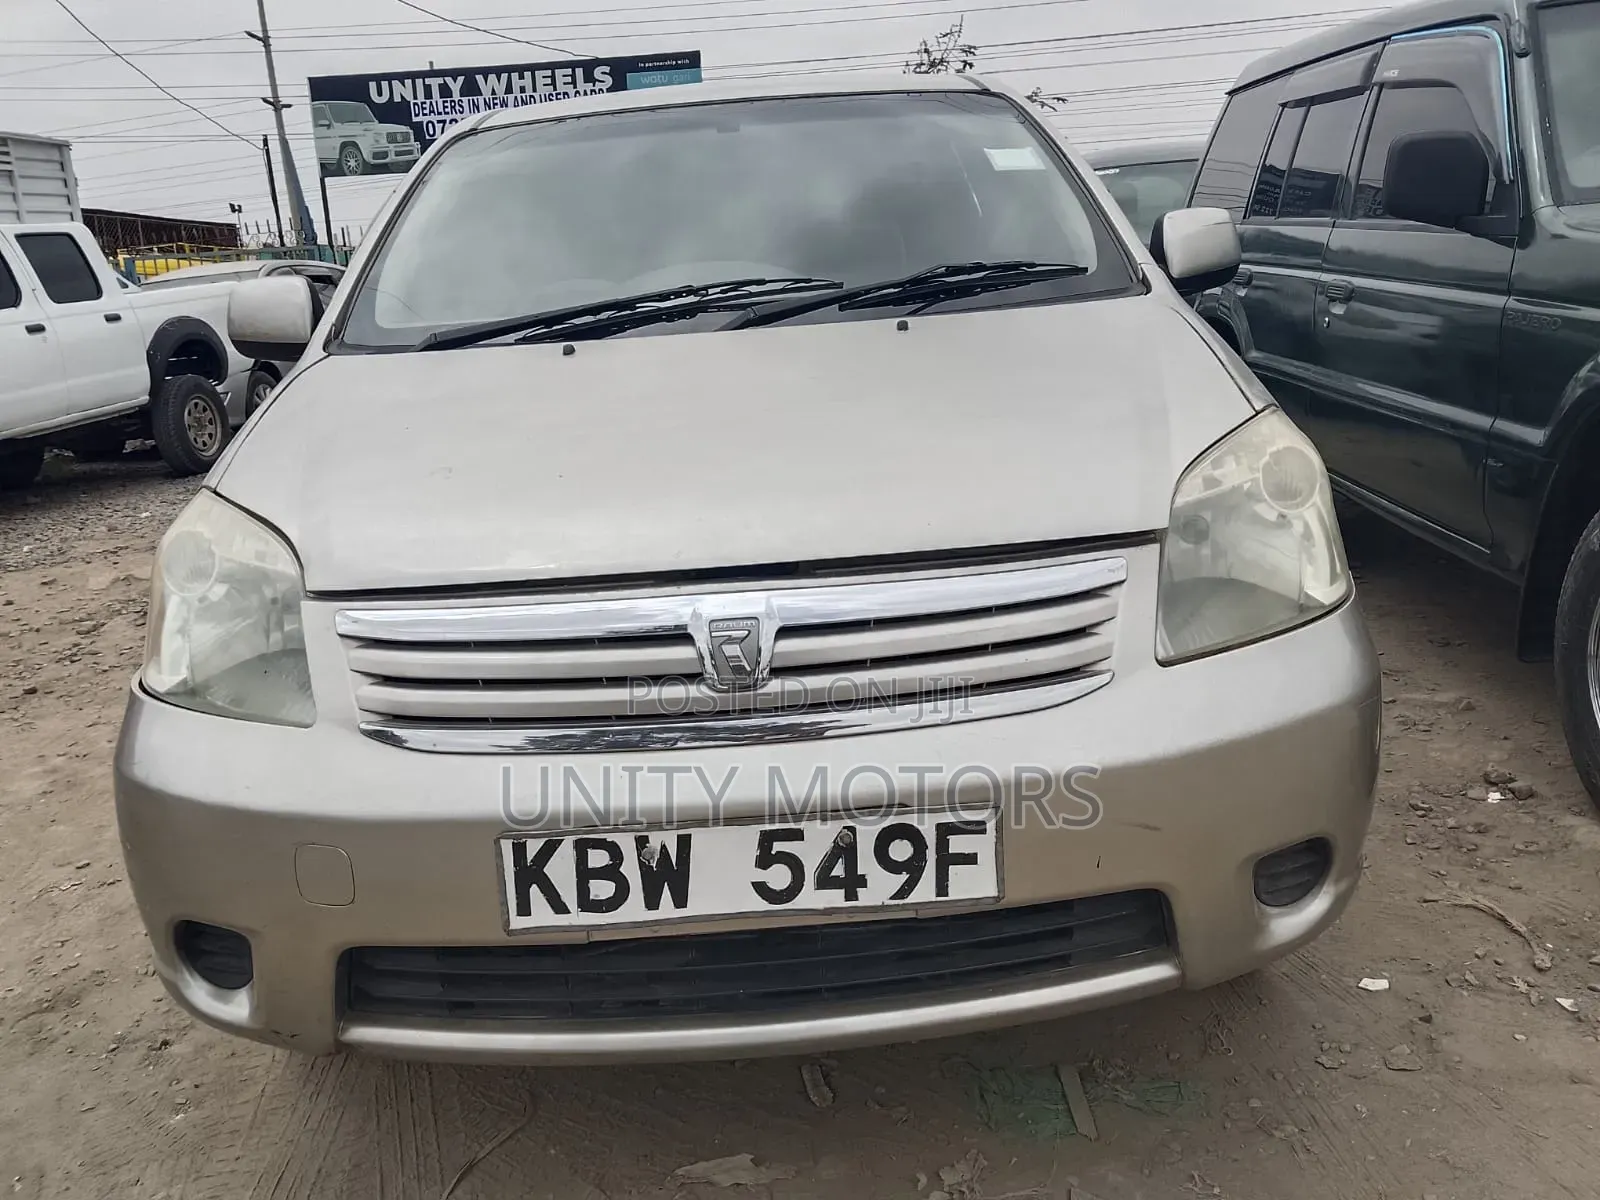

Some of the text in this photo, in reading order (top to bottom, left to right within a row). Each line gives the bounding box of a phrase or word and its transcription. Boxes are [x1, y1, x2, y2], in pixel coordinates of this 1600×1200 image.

[645, 59, 677, 68] partnership
[369, 65, 613, 104] UNITY WHEELS
[640, 73, 668, 84] watu
[412, 98, 465, 118] DEALERS
[468, 97, 480, 114] IN
[483, 96, 509, 112] NEW
[512, 820, 987, 917] KBW 549F
